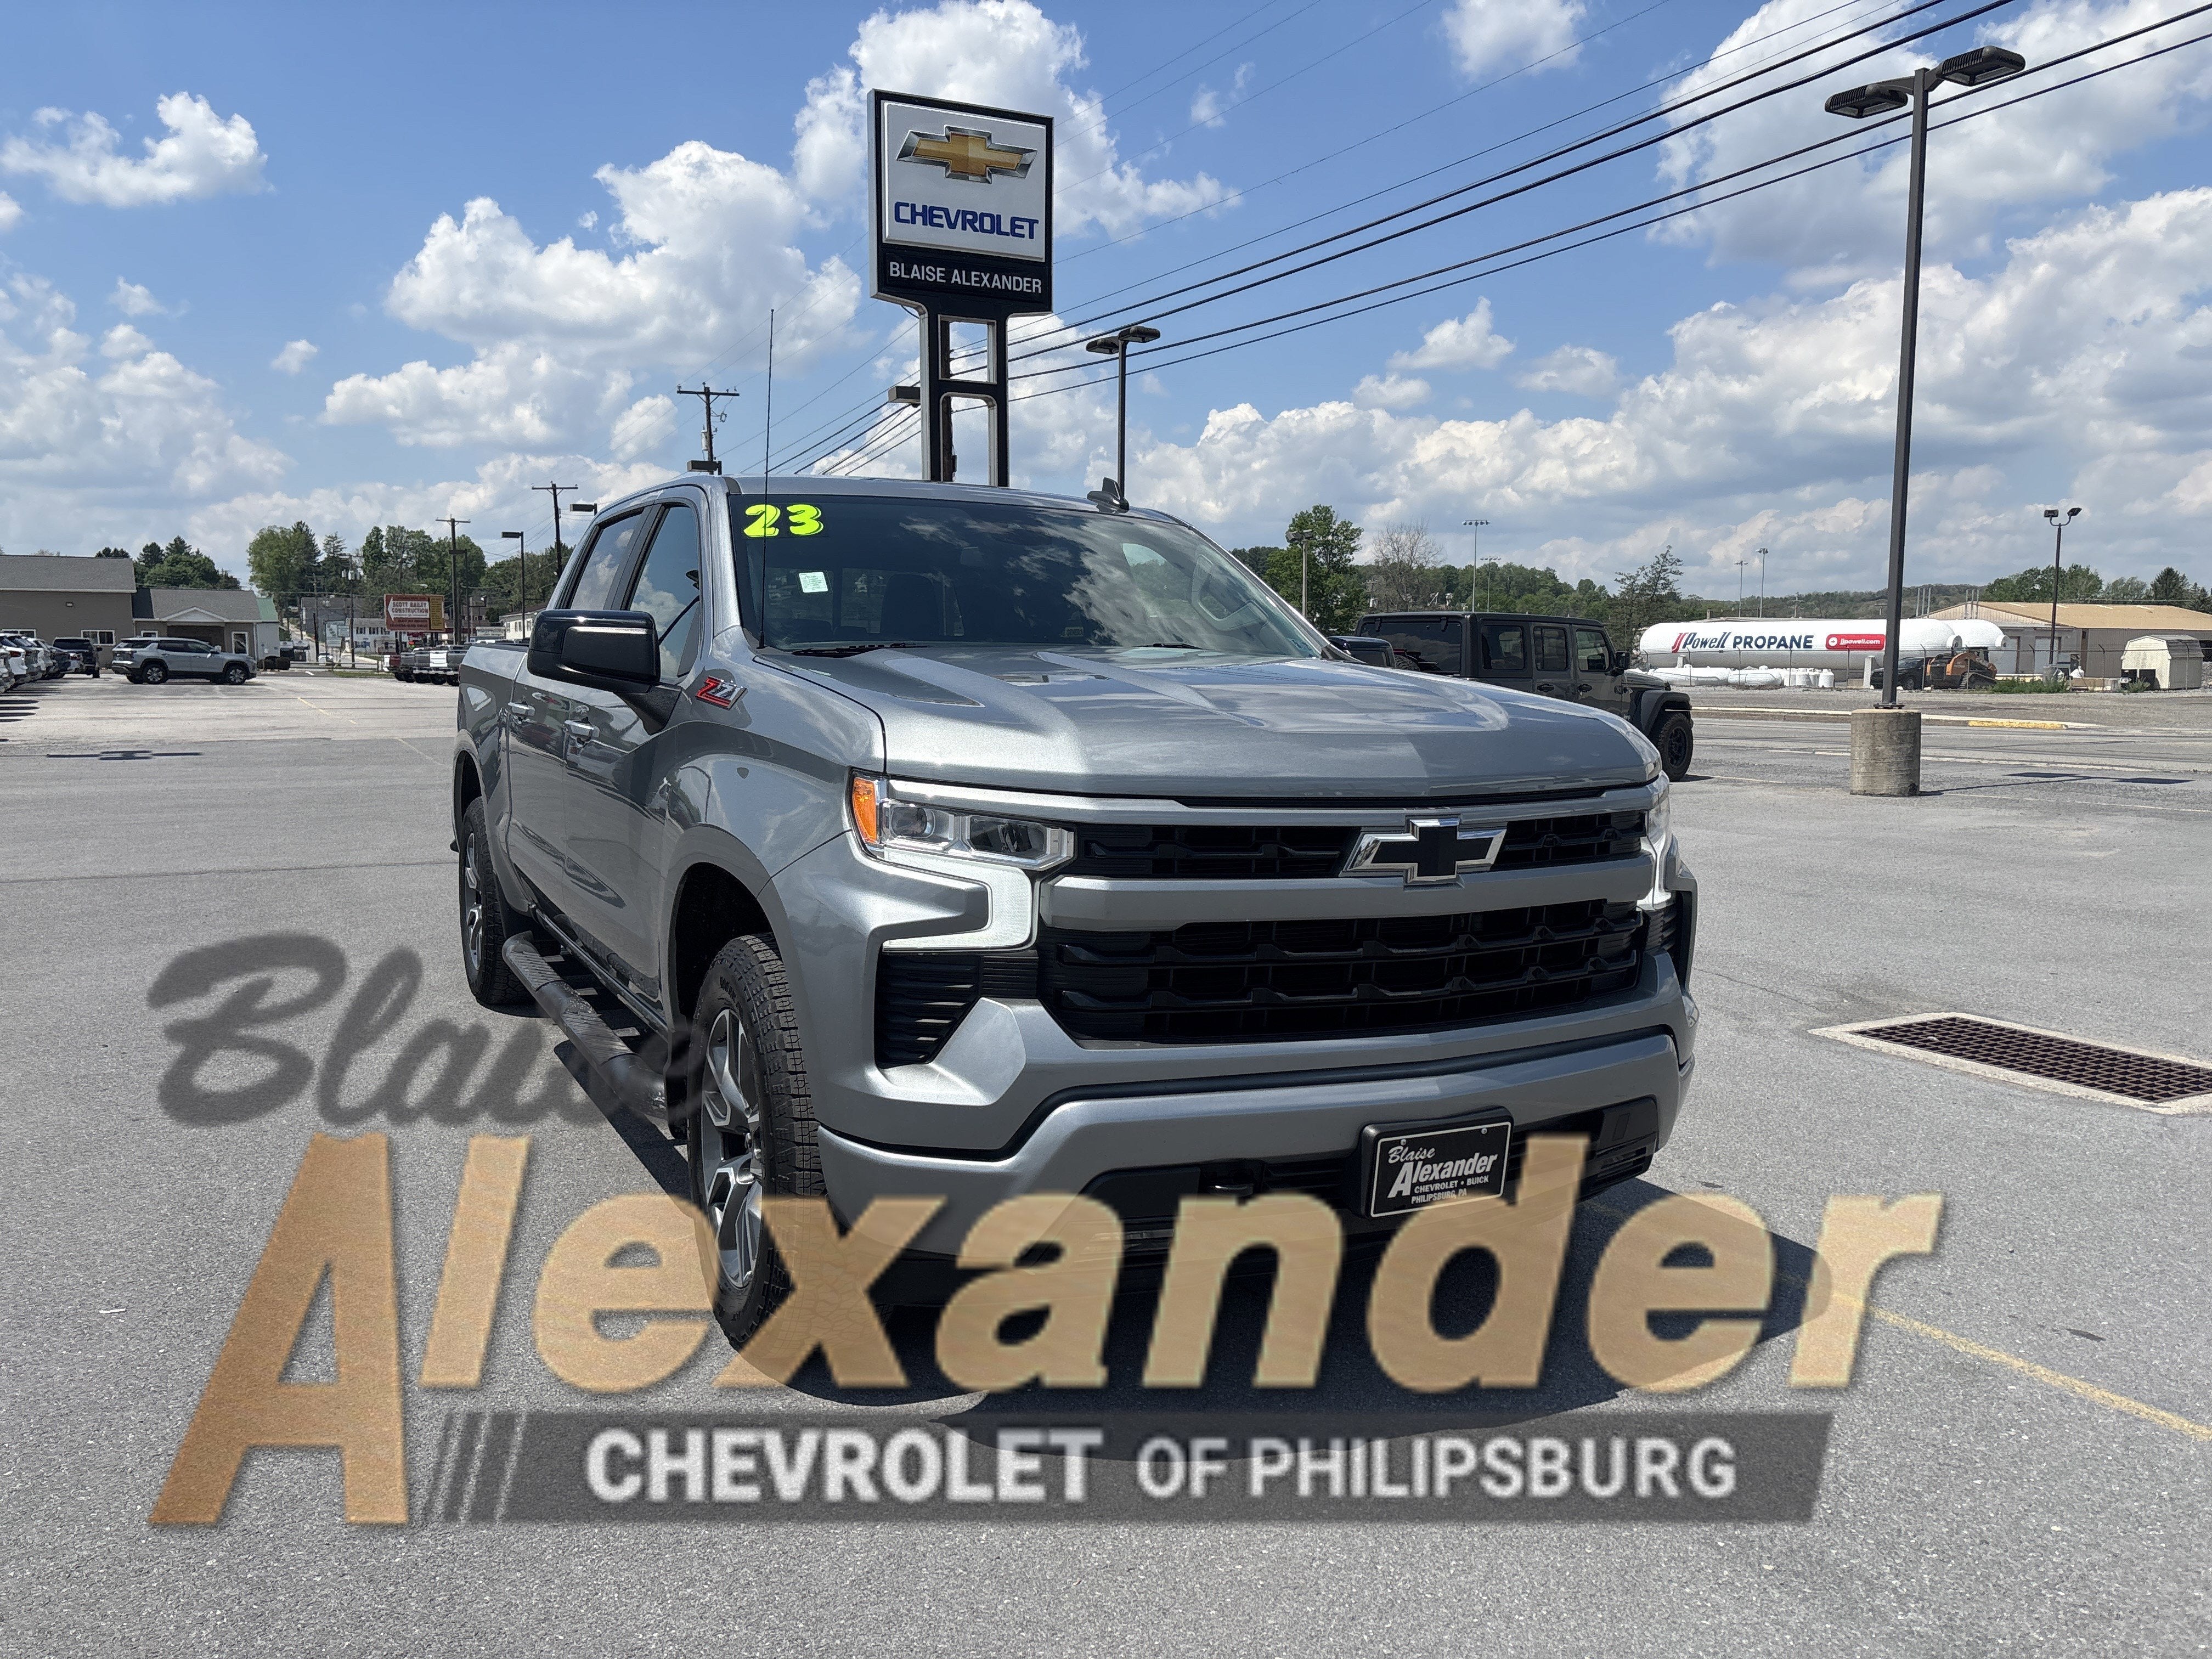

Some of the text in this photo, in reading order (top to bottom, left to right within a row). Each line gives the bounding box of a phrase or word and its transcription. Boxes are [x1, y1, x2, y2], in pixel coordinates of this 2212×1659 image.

[894, 201, 1039, 240] CHEVROLET
[889, 261, 1042, 294] BLAISE ALEXANDER
[743, 504, 824, 538] 23
[1733, 635, 1814, 649] PROPANE
[1387, 1145, 1436, 1164] Blaise
[1387, 1152, 1498, 1199] Alexander
[1414, 1175, 1489, 1194] CHEVROLET BUICK
[1458, 1188, 1468, 1197] PA
